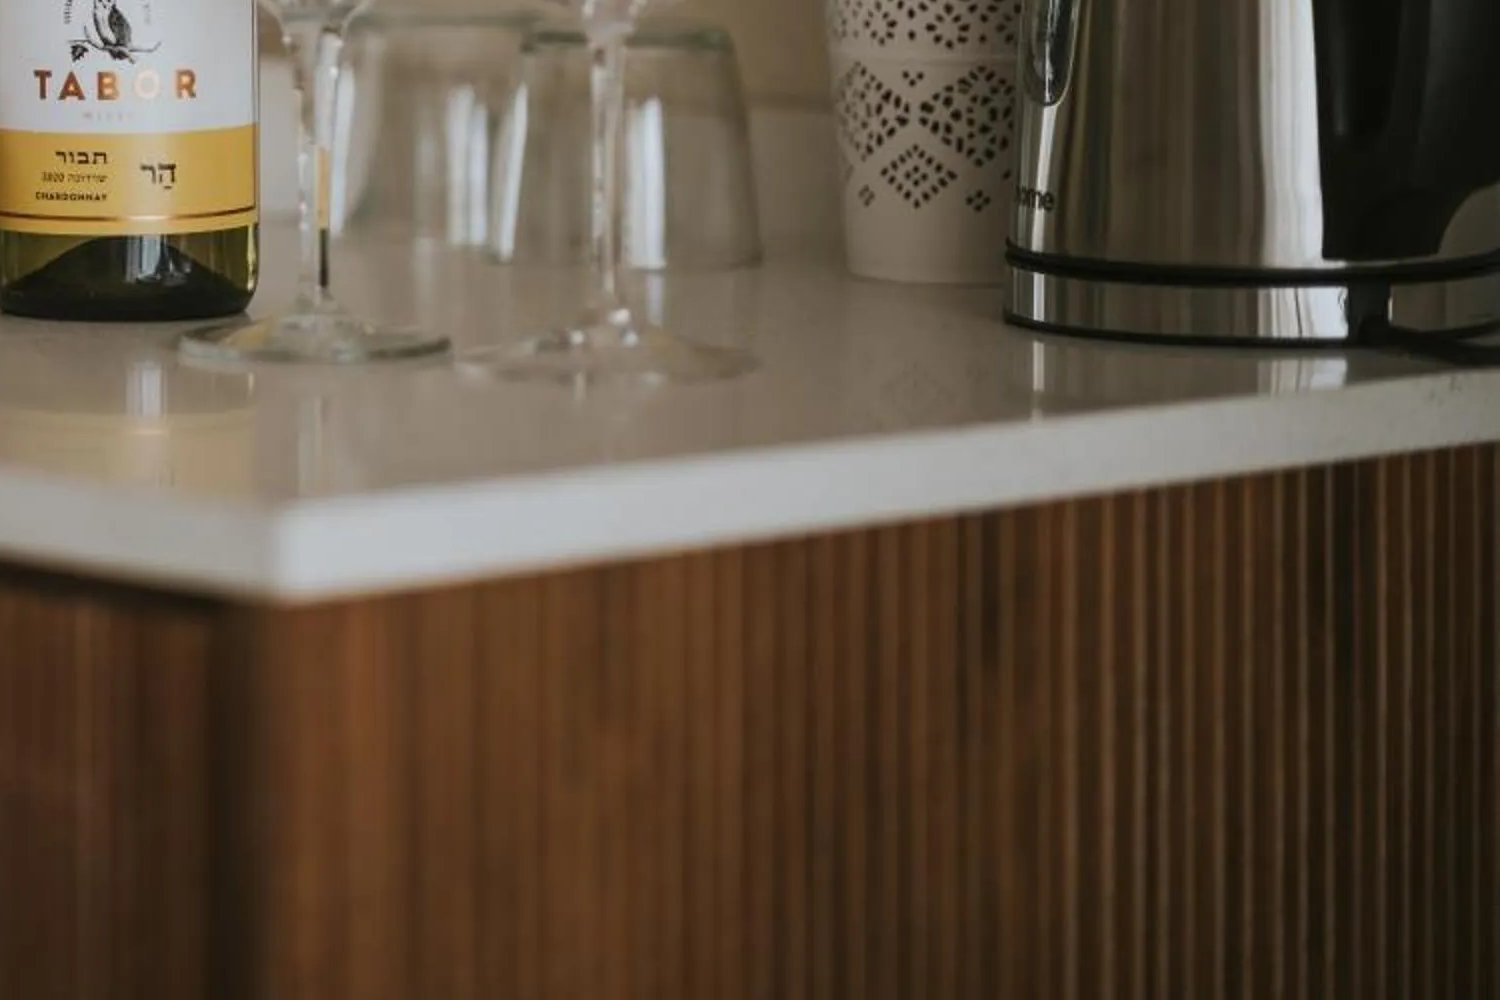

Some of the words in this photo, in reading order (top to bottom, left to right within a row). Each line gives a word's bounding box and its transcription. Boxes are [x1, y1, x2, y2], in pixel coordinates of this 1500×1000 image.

[34, 69, 197, 101] TABOR
[55, 150, 108, 165] תבור
[35, 190, 108, 202] CHARDONNAY
